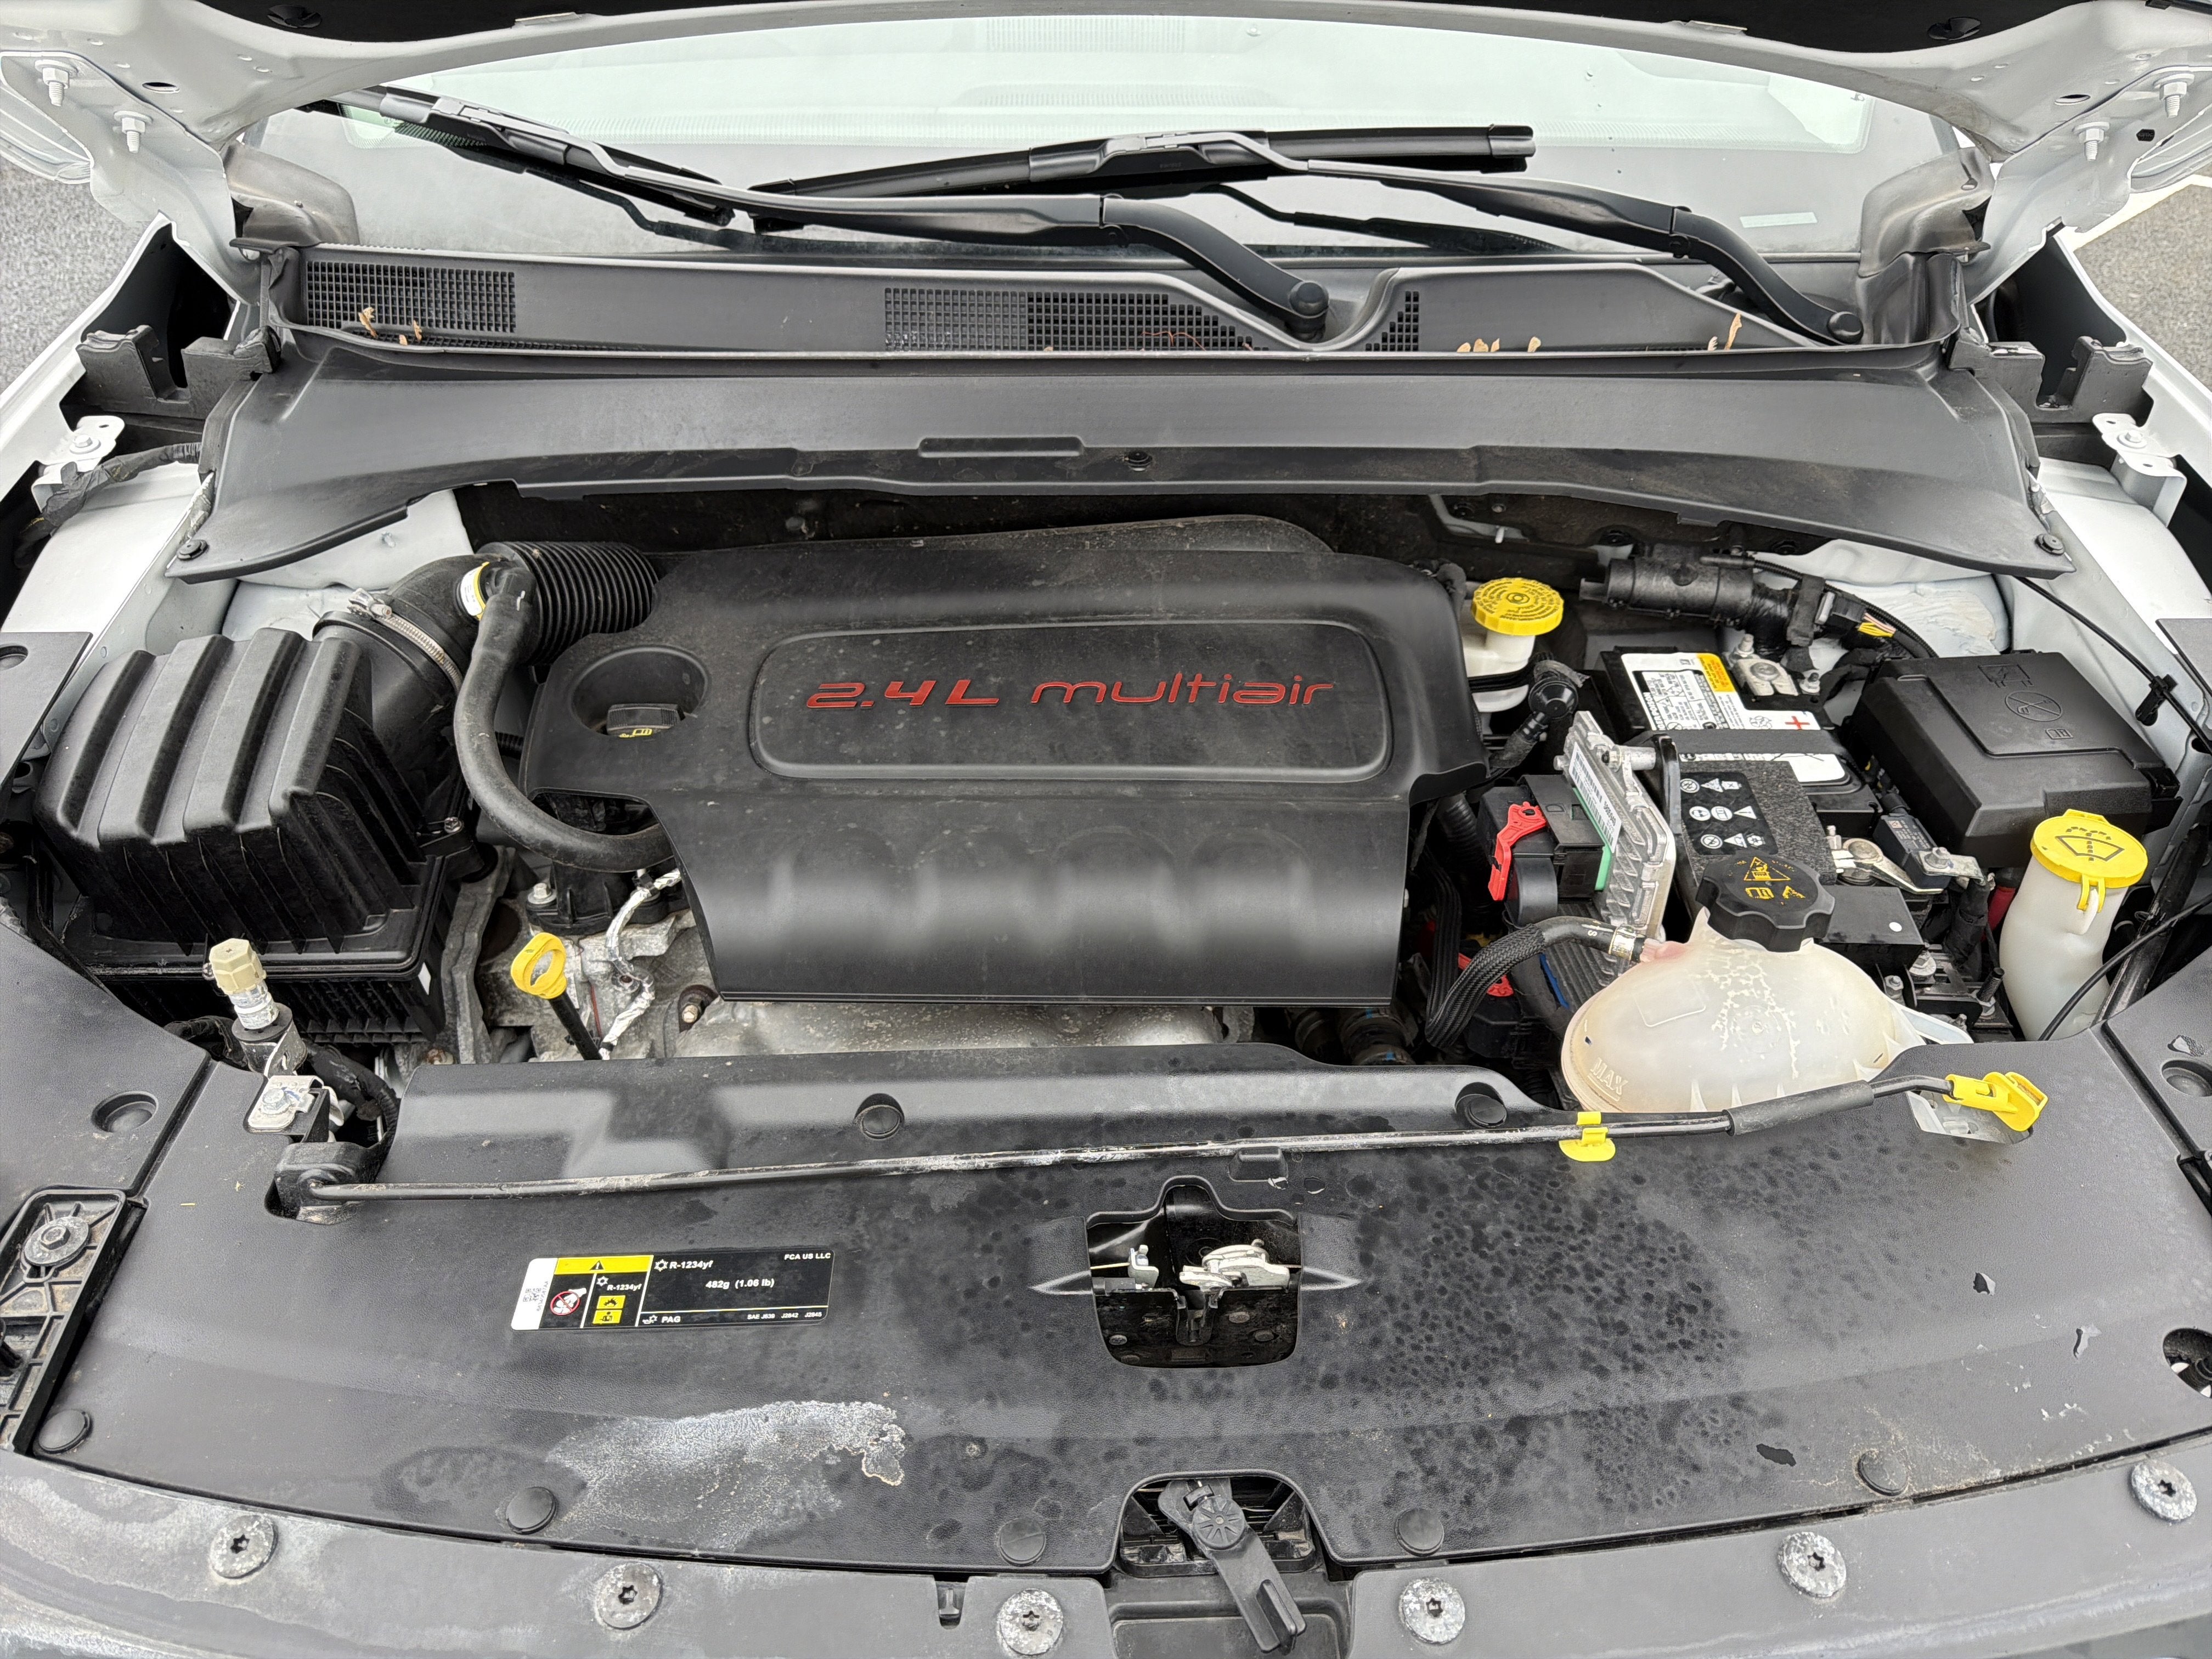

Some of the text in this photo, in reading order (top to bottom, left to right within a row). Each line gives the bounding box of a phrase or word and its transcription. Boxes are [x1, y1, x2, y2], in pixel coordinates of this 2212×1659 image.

[1031, 671, 1334, 704] multiair
[1590, 1057, 1629, 1096] MAX
[669, 1260, 714, 1270] R-1234yf
[705, 1278, 775, 1290] 482g (1.06 lb)
